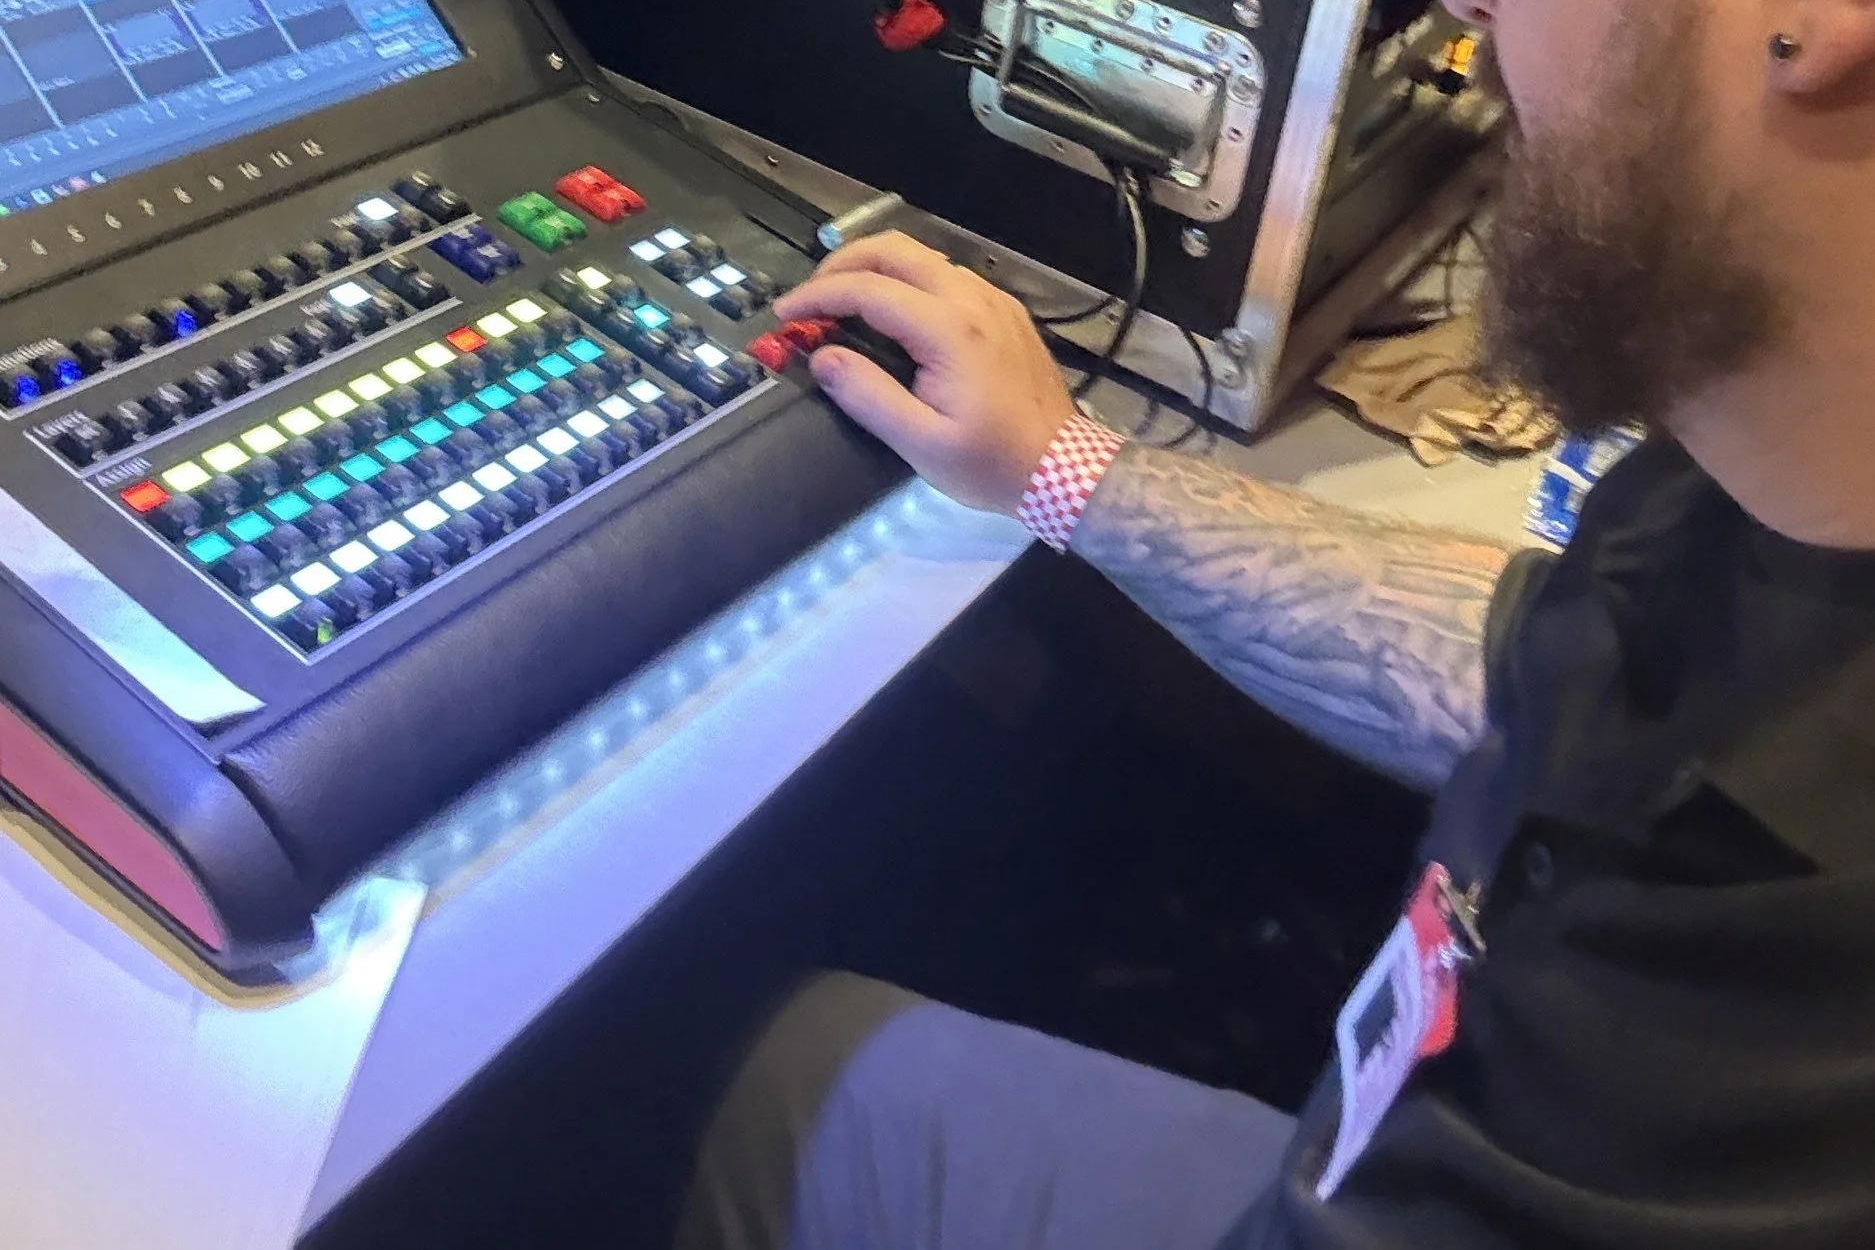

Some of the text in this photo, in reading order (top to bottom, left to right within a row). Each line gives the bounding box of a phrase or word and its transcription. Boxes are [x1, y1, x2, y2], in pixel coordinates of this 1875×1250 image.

[237, 161, 263, 180] 10
[269, 150, 294, 168] 11
[301, 138, 325, 157] 12
